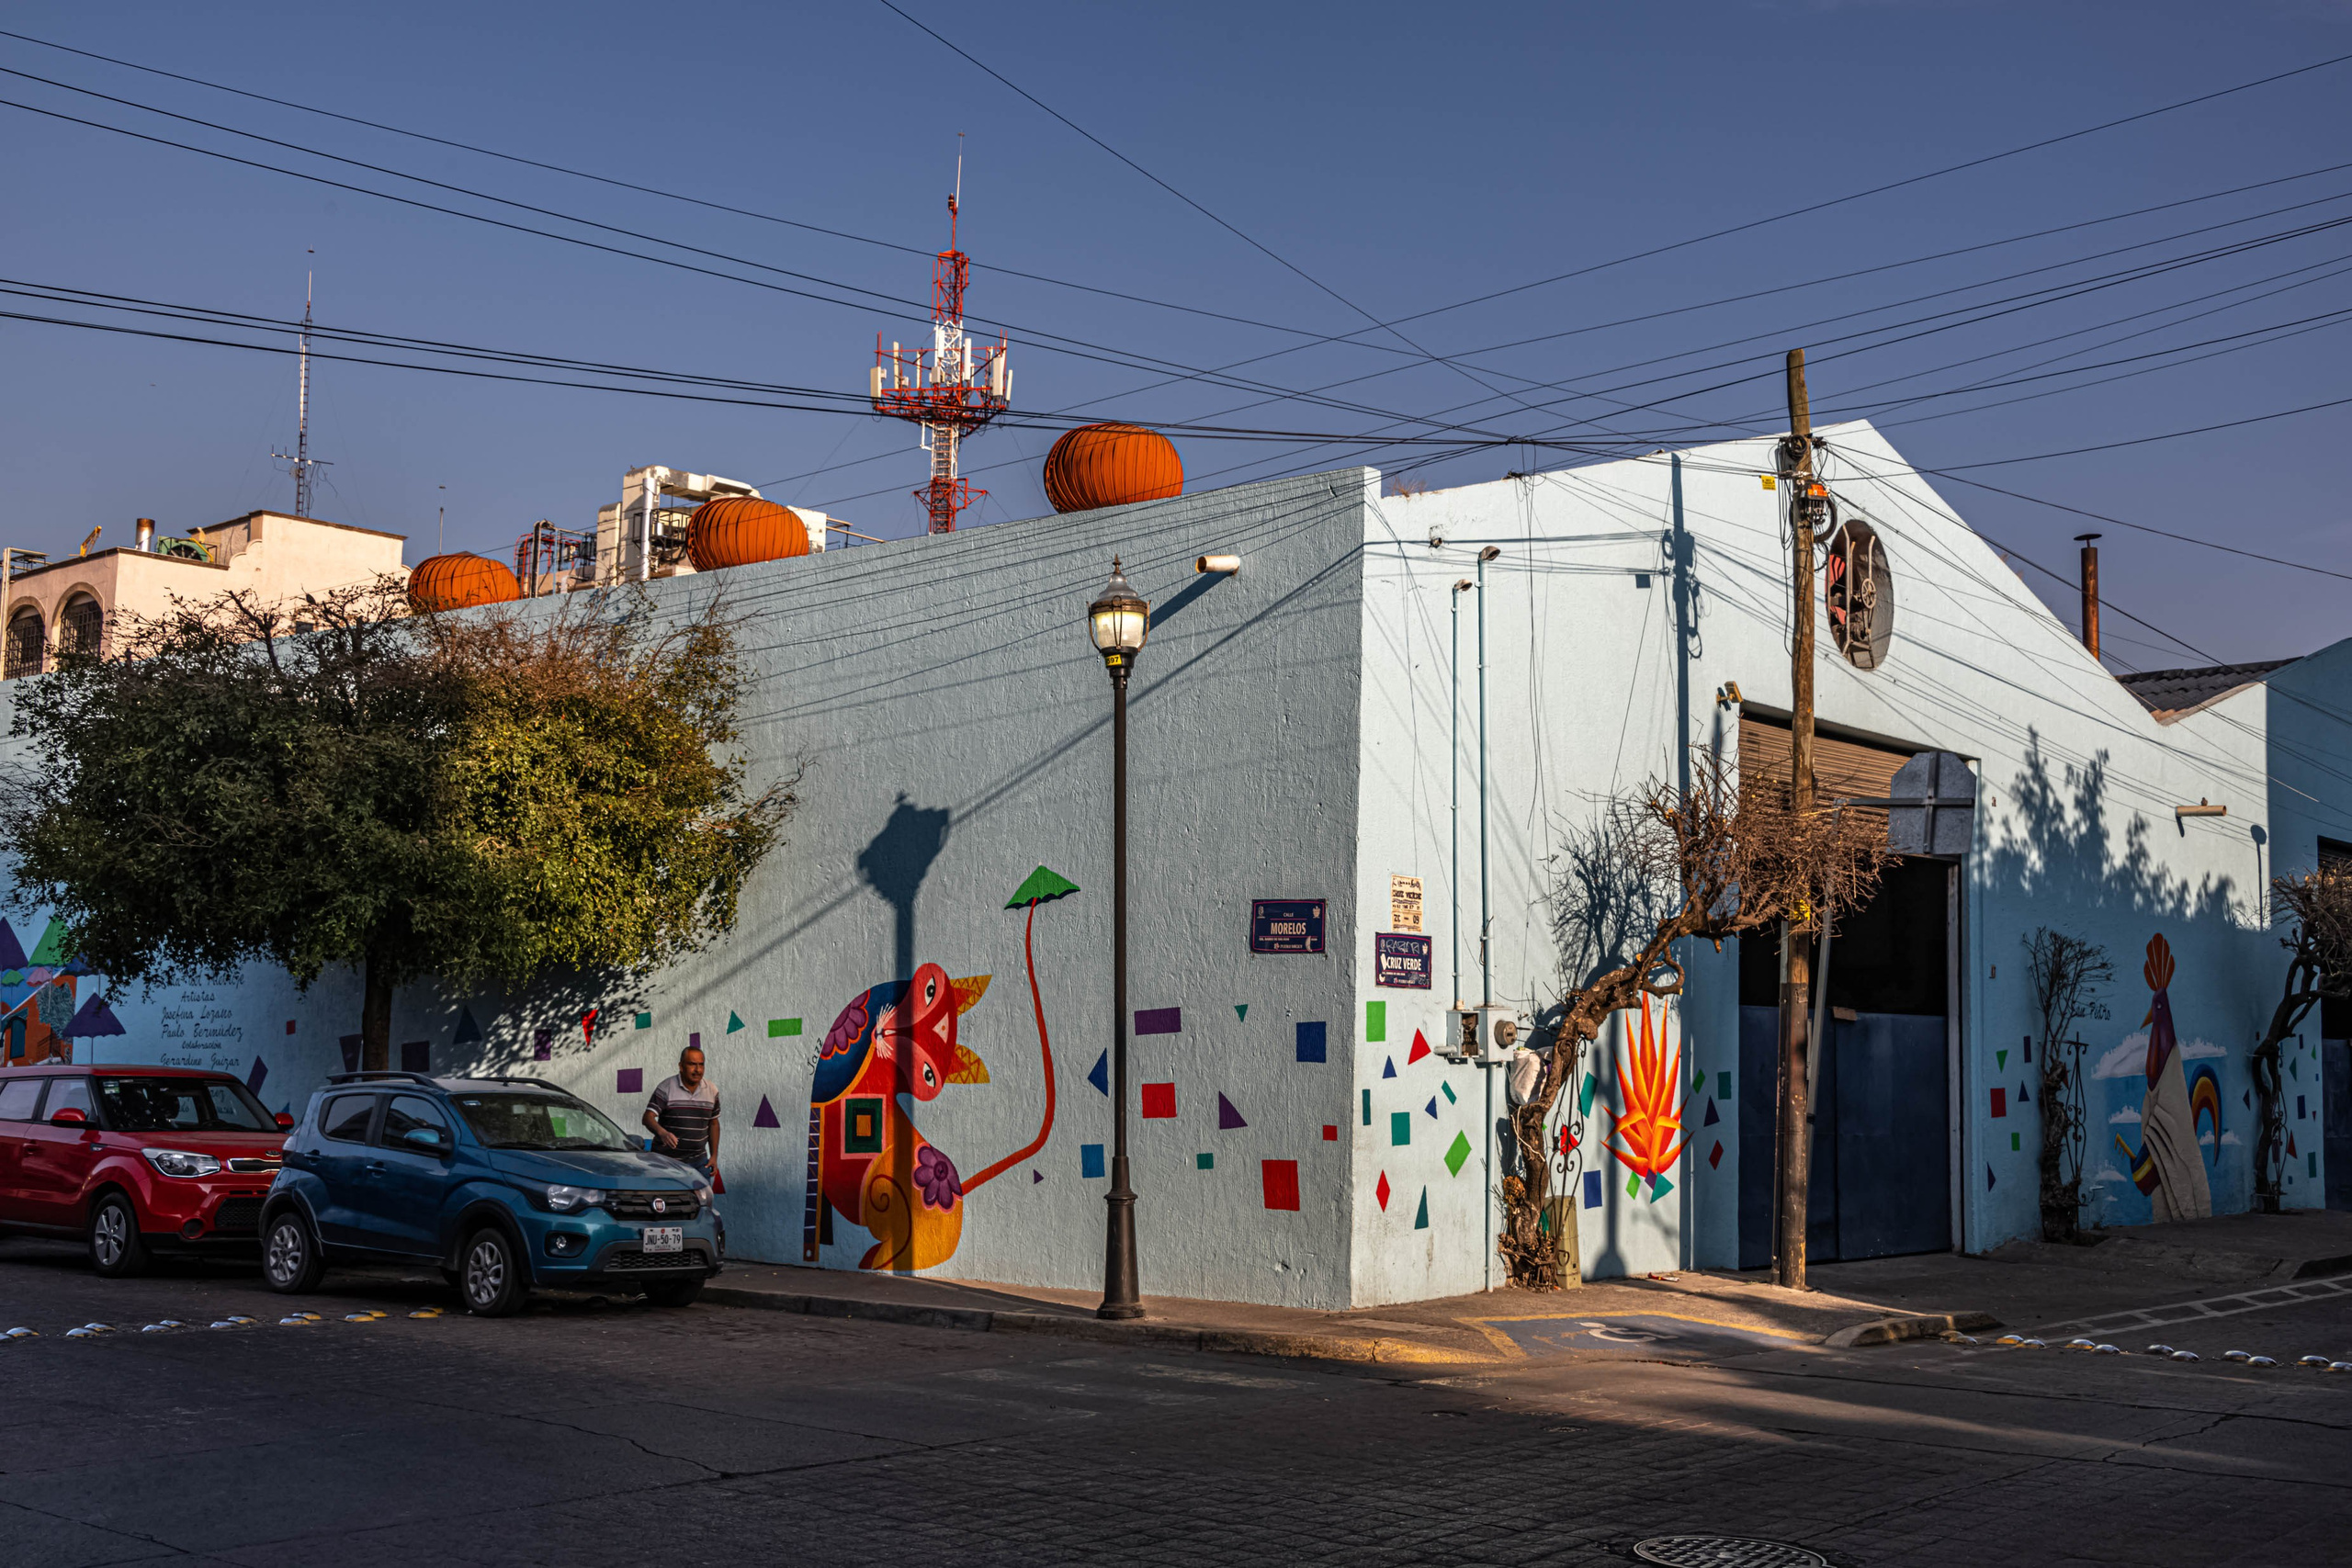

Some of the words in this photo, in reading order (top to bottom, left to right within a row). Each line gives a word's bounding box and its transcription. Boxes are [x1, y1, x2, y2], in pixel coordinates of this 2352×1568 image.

[1270, 922, 1306, 935] MORELOS
[1387, 956, 1402, 970] CRUZ
[1403, 957, 1422, 971] VERDE
[181, 991, 215, 1003] Artistas
[161, 1005, 194, 1024] Josefina
[200, 1005, 232, 1023] Lozano
[162, 1023, 185, 1039] Paulo
[194, 1022, 243, 1043] Bermúdez
[645, 1235, 681, 1246] JNU-50-79
